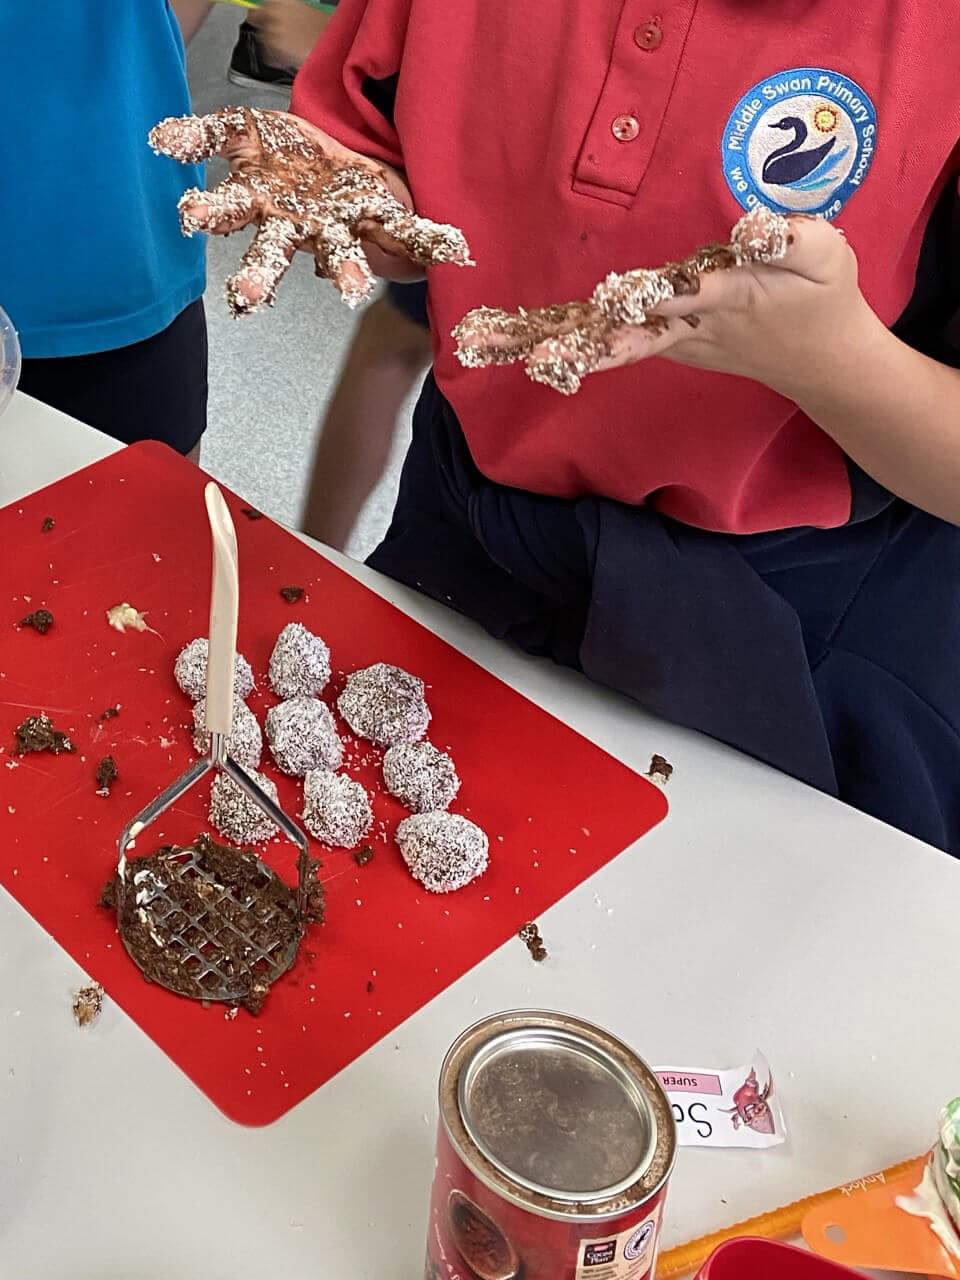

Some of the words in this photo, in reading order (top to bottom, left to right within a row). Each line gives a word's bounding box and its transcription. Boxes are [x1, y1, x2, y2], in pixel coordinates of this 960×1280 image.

[728, 98, 763, 151] Middle
[762, 77, 812, 100] Swan
[816, 75, 870, 123] Primary
[850, 124, 876, 186] School
[662, 1076, 698, 1087] SUPER
